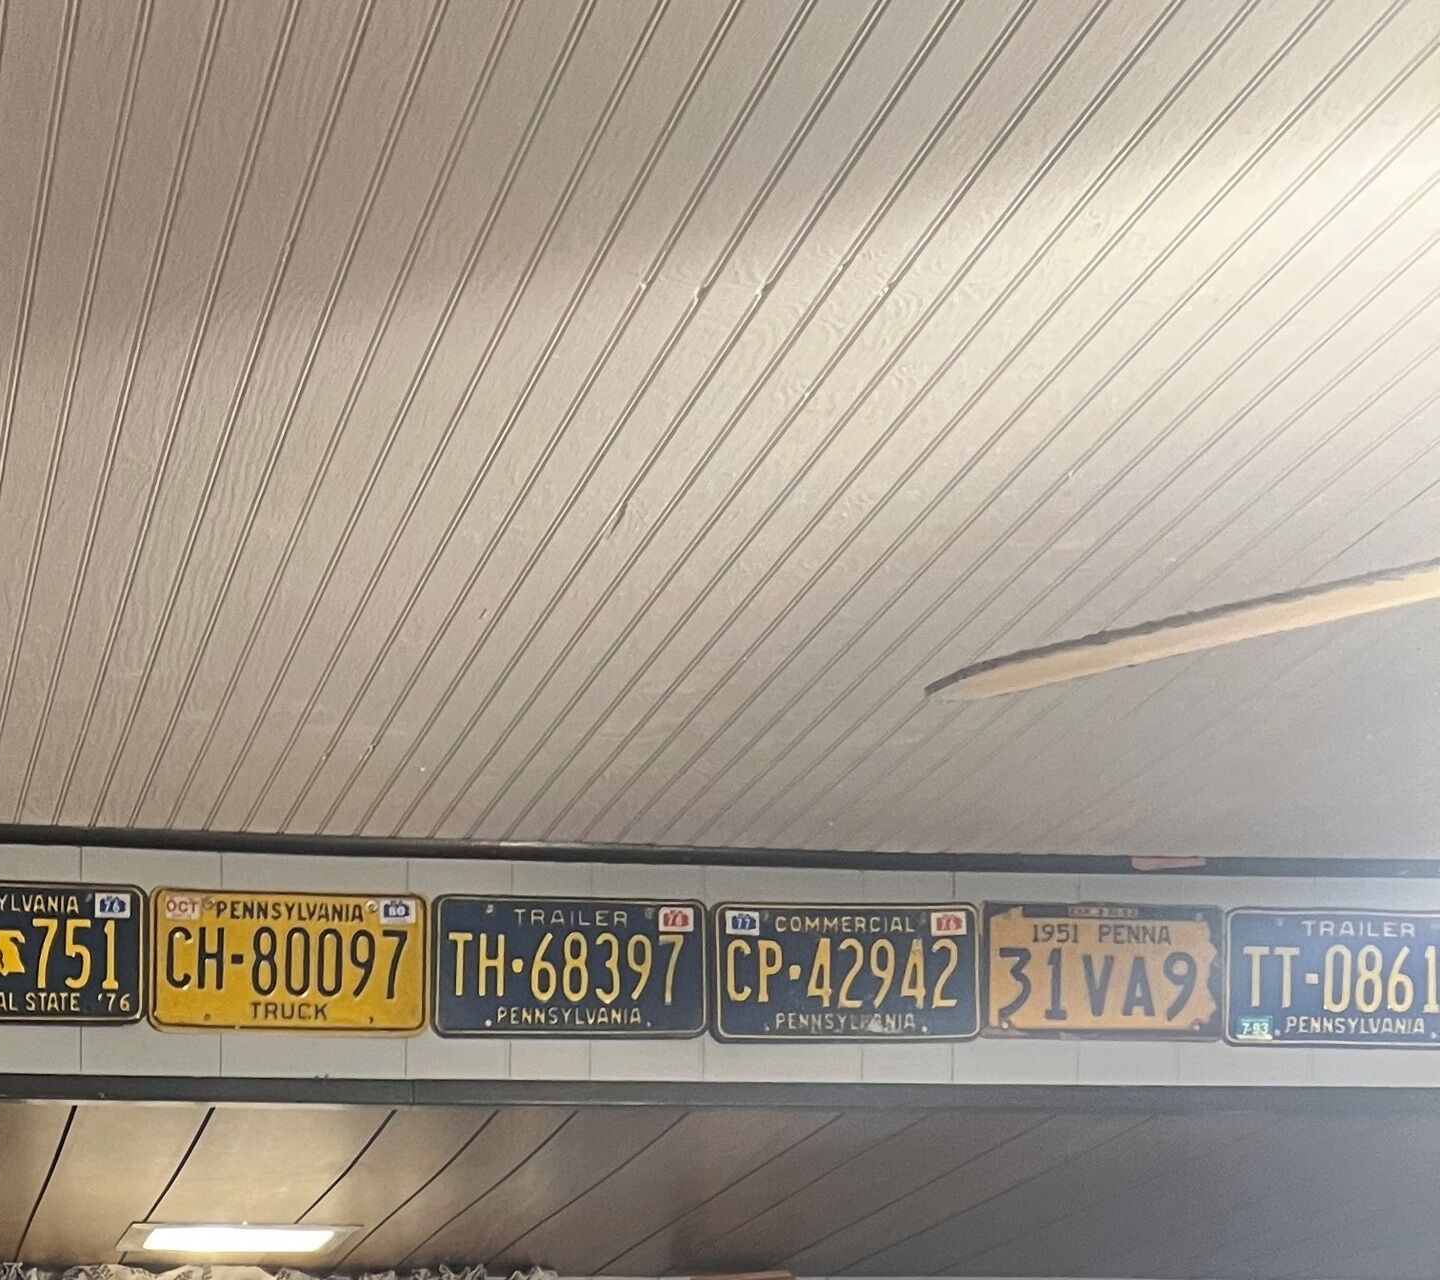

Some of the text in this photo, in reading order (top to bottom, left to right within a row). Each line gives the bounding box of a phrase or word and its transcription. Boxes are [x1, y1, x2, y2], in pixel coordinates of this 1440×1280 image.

[104, 899, 120, 913] 76
[166, 900, 198, 913] OCT
[216, 900, 364, 923] PENNSYLVANIA
[514, 908, 629, 928] TRAILER
[737, 918, 751, 929] 77
[774, 916, 916, 934] COMMERCIAL
[1032, 923, 1172, 946] 1951 PENNA
[1301, 920, 1417, 938] TRAILER
[32, 917, 120, 990] 751
[165, 926, 408, 1000] CH-80097
[997, 947, 1197, 1022] 31VA9
[1242, 944, 1440, 1014] TT-0861
[25, 992, 81, 1012] STATE
[250, 1002, 329, 1022] TRUCK
[496, 1006, 642, 1025] PENNSYLVANIA
[1284, 1016, 1425, 1035] PENNSYLVANIA
